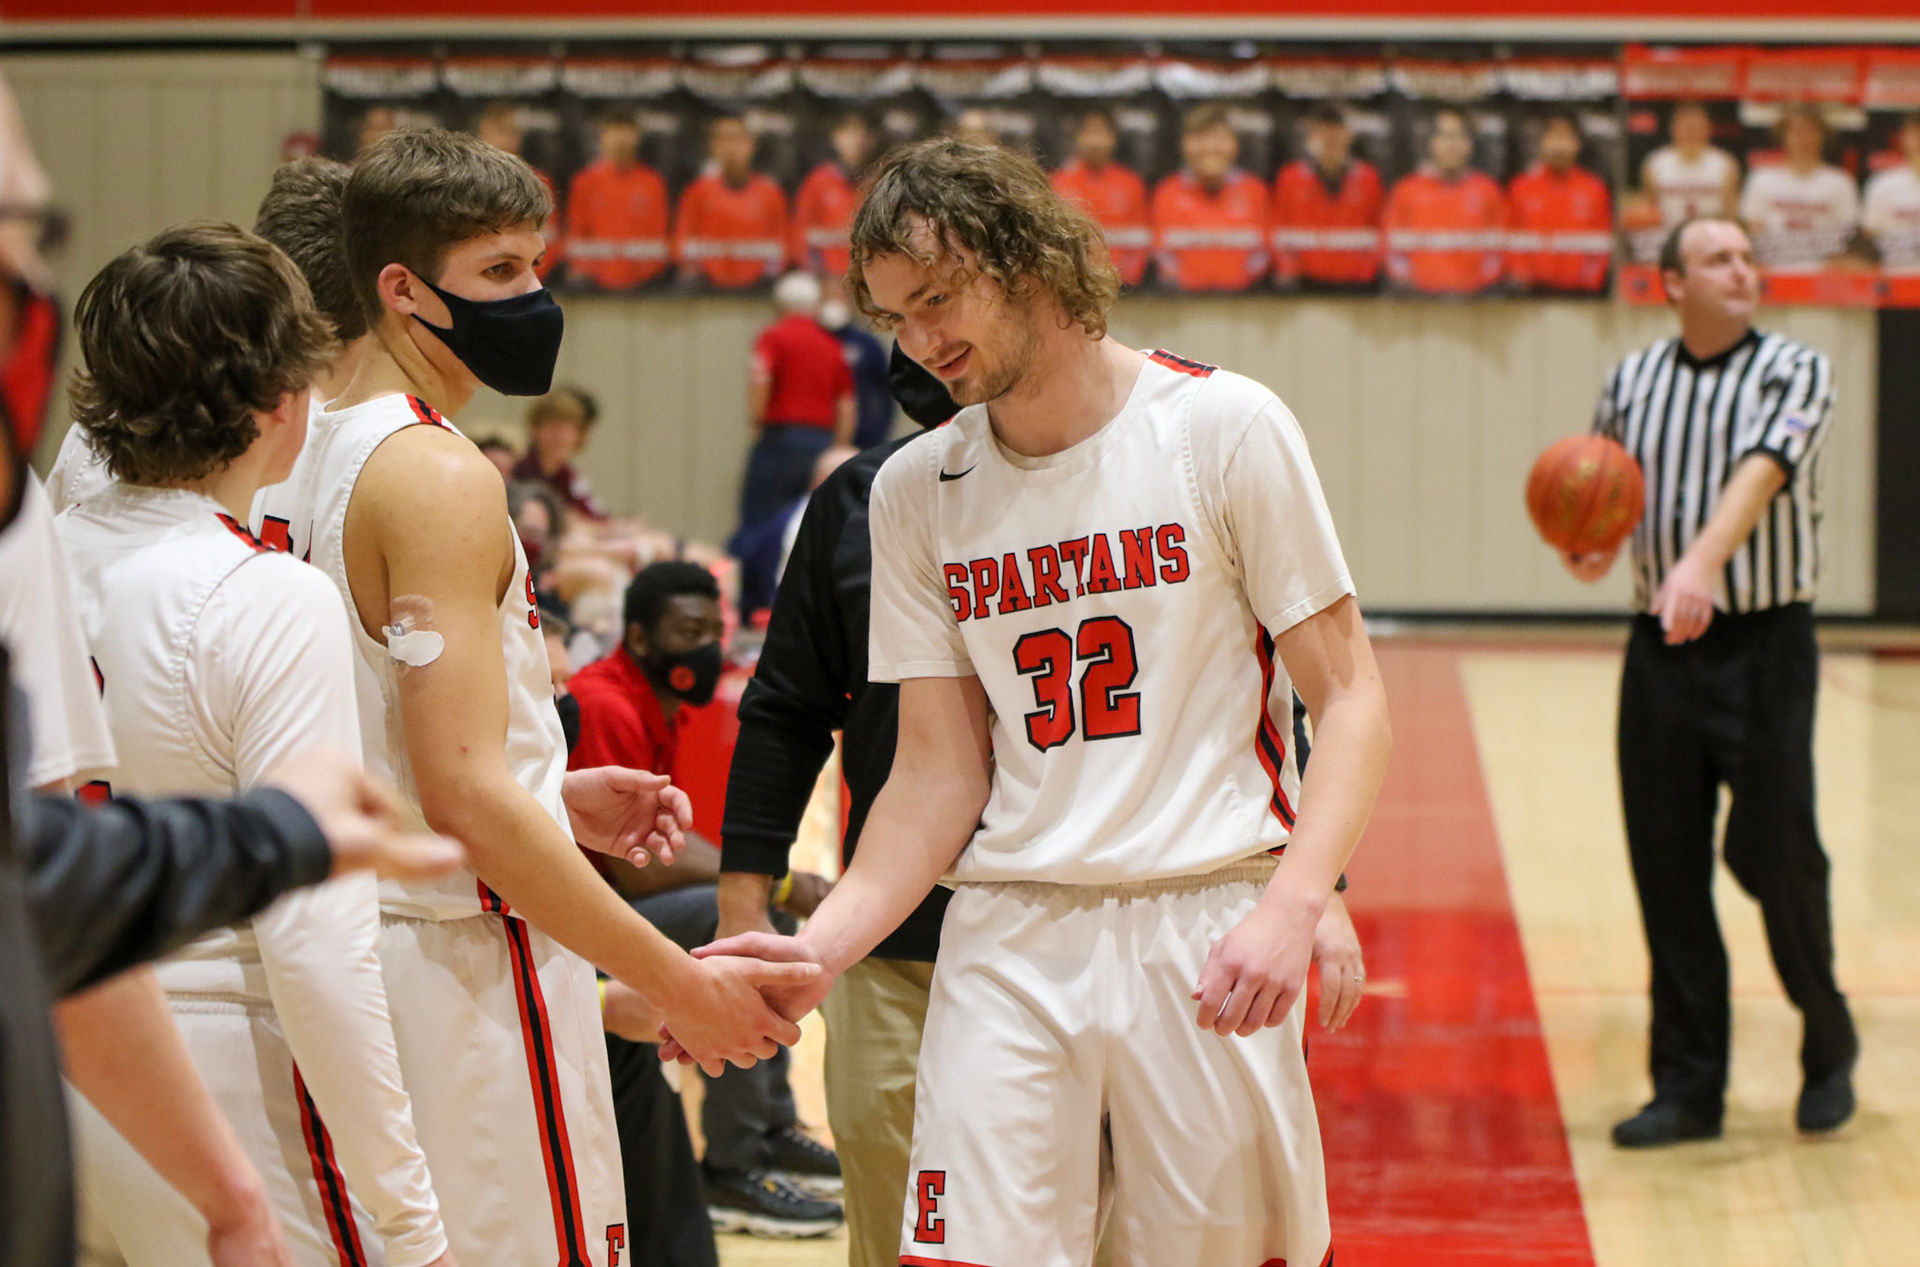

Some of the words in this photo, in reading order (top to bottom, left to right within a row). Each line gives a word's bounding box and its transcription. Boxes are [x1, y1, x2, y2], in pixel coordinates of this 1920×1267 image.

[943, 522, 1190, 622] SPARTANS
[1012, 615, 1142, 753] 32
[914, 1170, 946, 1244] E
